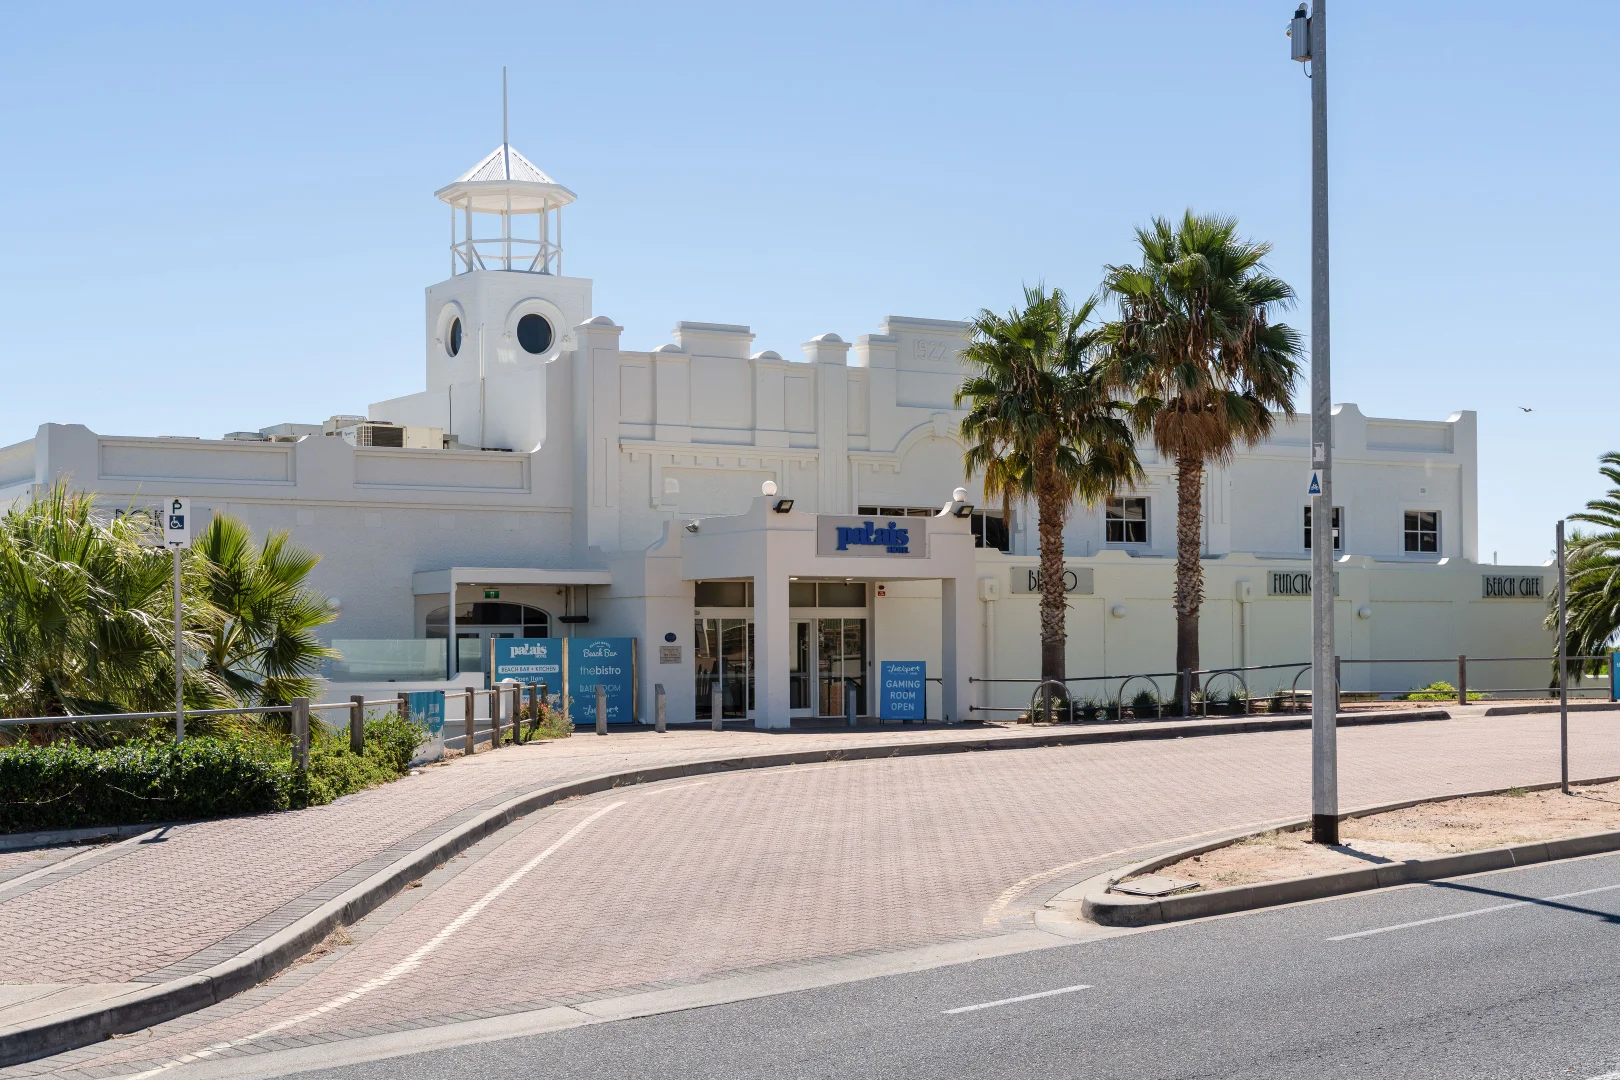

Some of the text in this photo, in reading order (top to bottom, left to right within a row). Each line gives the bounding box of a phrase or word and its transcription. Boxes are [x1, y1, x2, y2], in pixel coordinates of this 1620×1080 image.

[913, 338, 949, 362] 1922
[836, 521, 909, 550] palais
[1486, 577, 1541, 596] BEACH CAFE
[510, 643, 547, 658] palais
[583, 648, 618, 657] Beach Bar
[886, 680, 920, 688] GAMING
[890, 691, 916, 699] ROOM
[891, 702, 914, 710] OPEN
